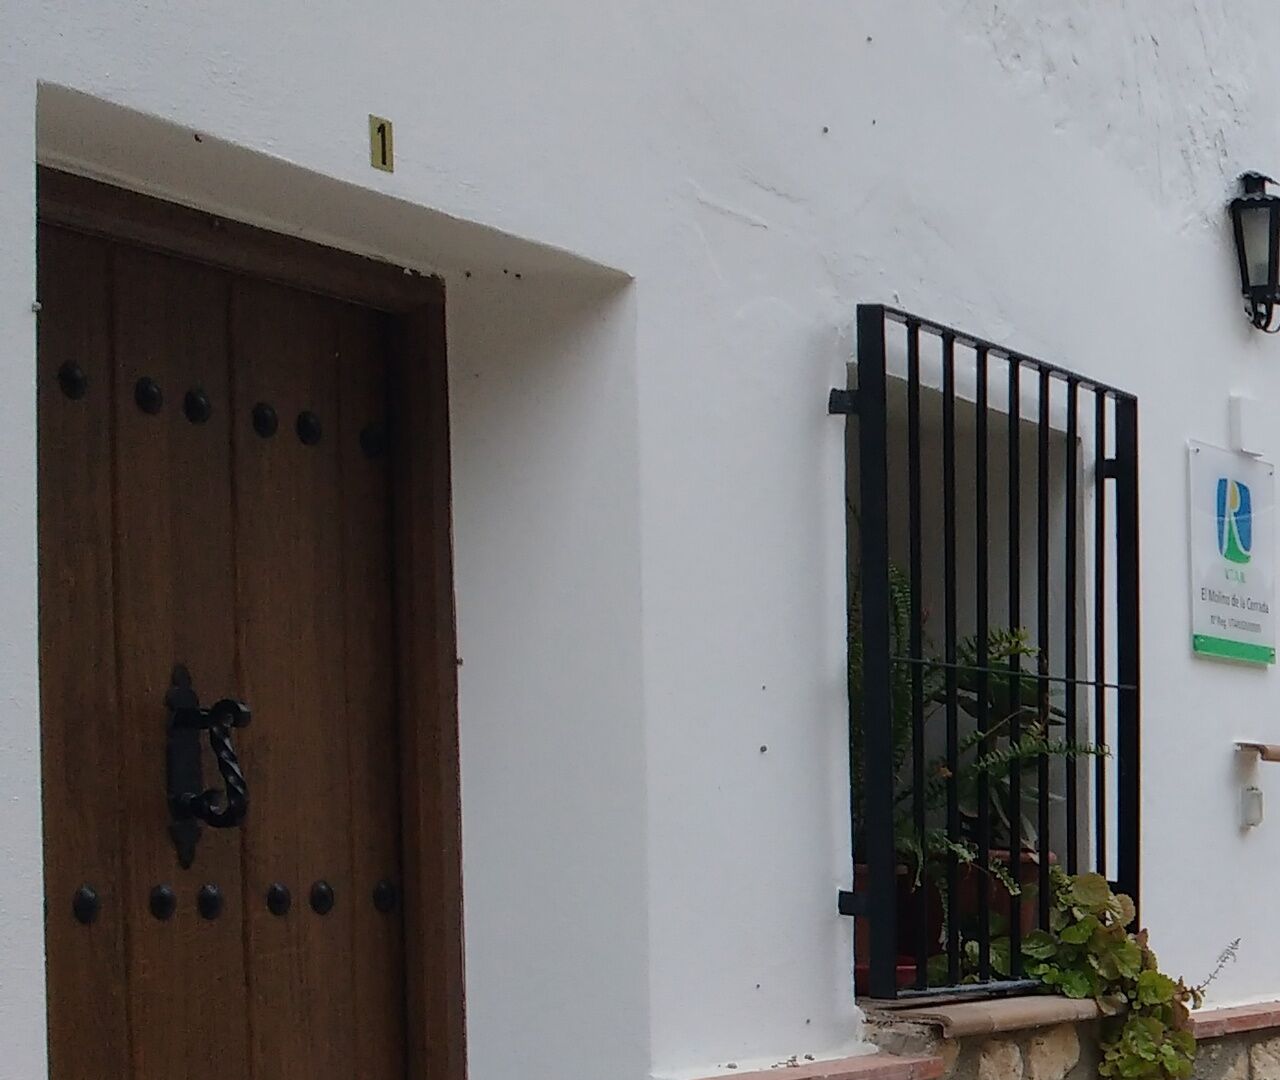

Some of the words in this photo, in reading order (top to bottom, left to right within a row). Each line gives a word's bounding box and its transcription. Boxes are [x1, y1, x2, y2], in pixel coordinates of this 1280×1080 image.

[377, 123, 387, 166] 1
[1208, 590, 1230, 606] Molino
[1231, 594, 1239, 608] de
[1247, 597, 1269, 614] Cerrada
